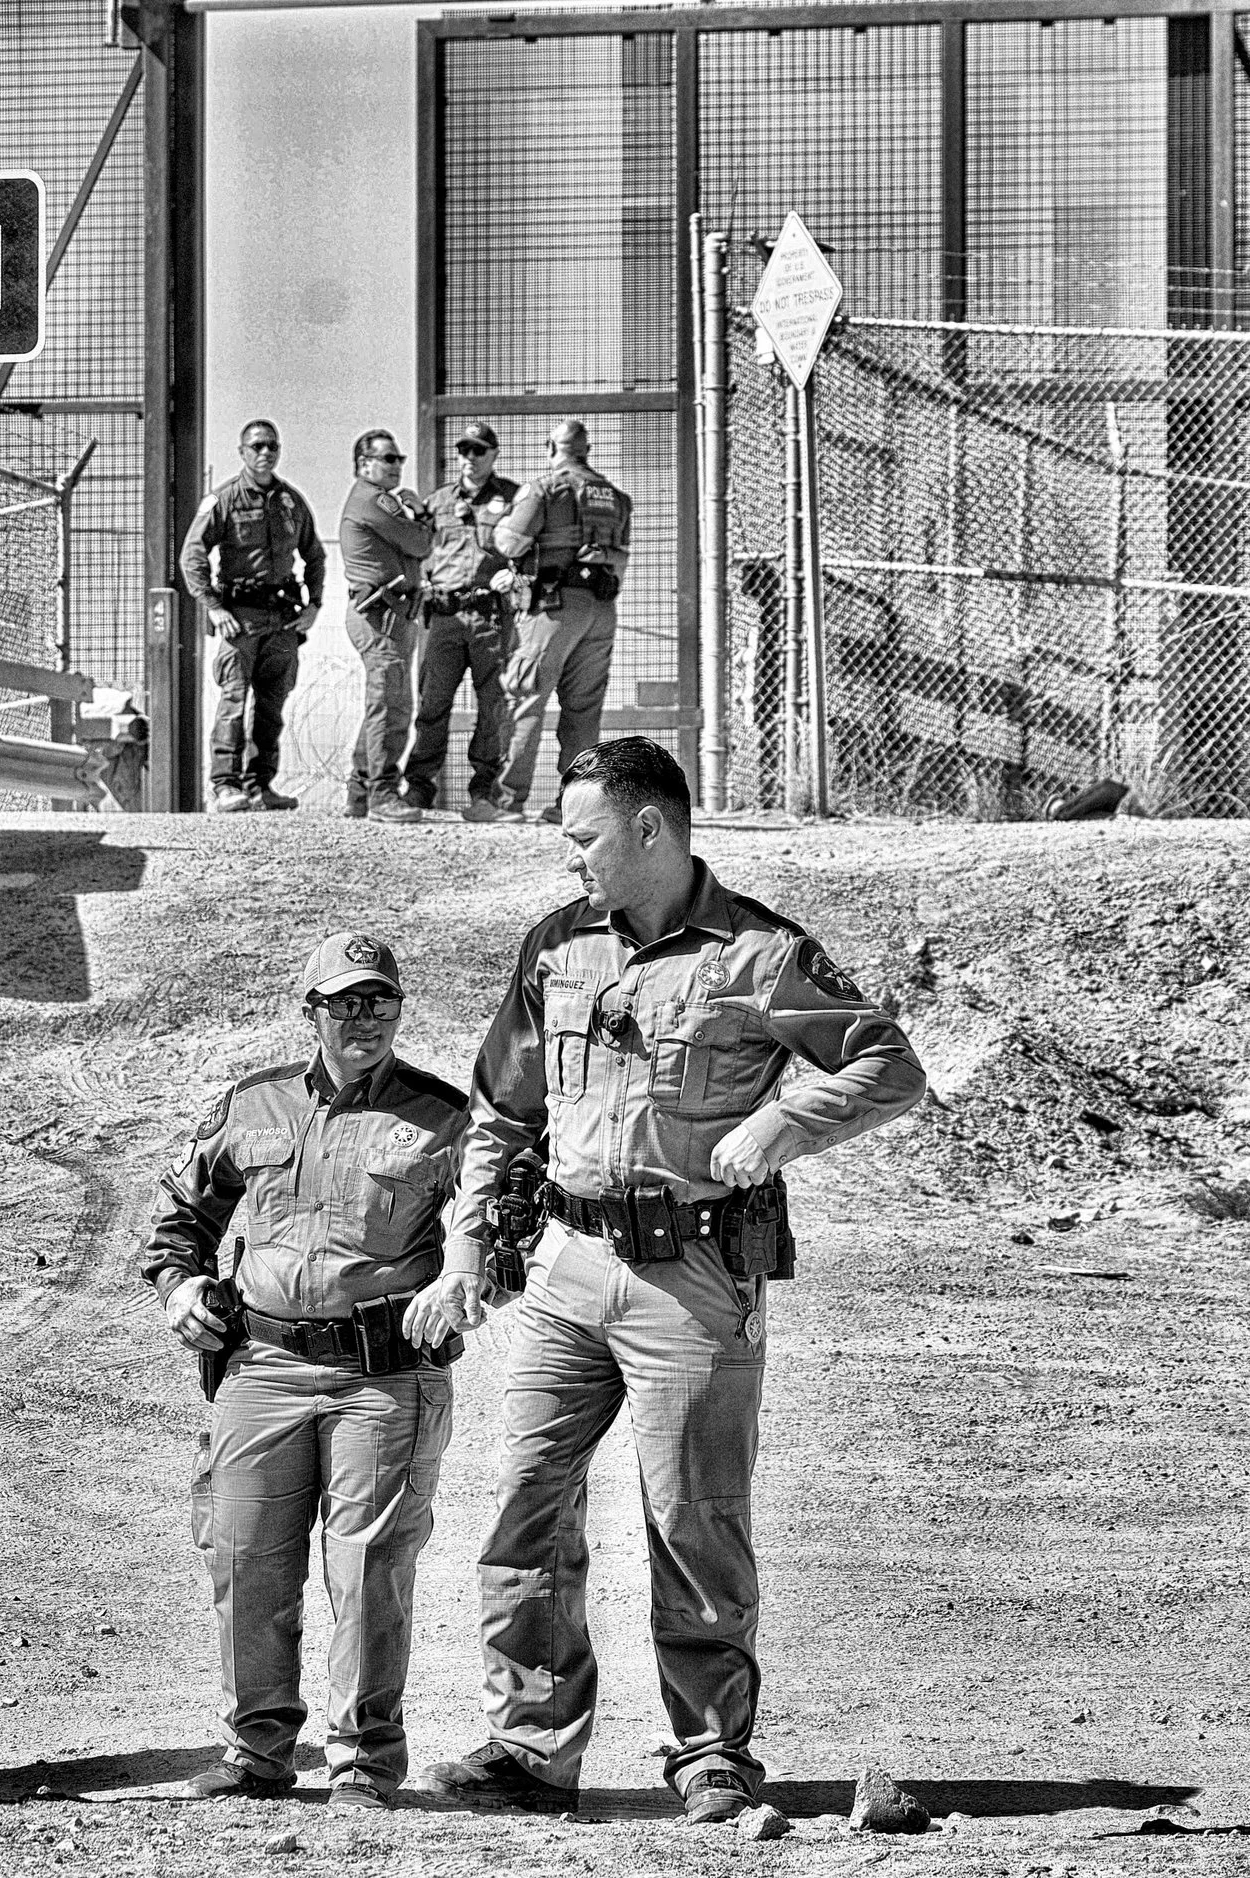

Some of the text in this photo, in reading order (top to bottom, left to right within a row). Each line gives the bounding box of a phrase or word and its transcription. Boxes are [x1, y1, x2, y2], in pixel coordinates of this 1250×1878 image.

[760, 286, 834, 314] DO NOT TRESPASS
[586, 485, 615, 500] POLICE
[246, 1127, 288, 1137] REYNOSO
